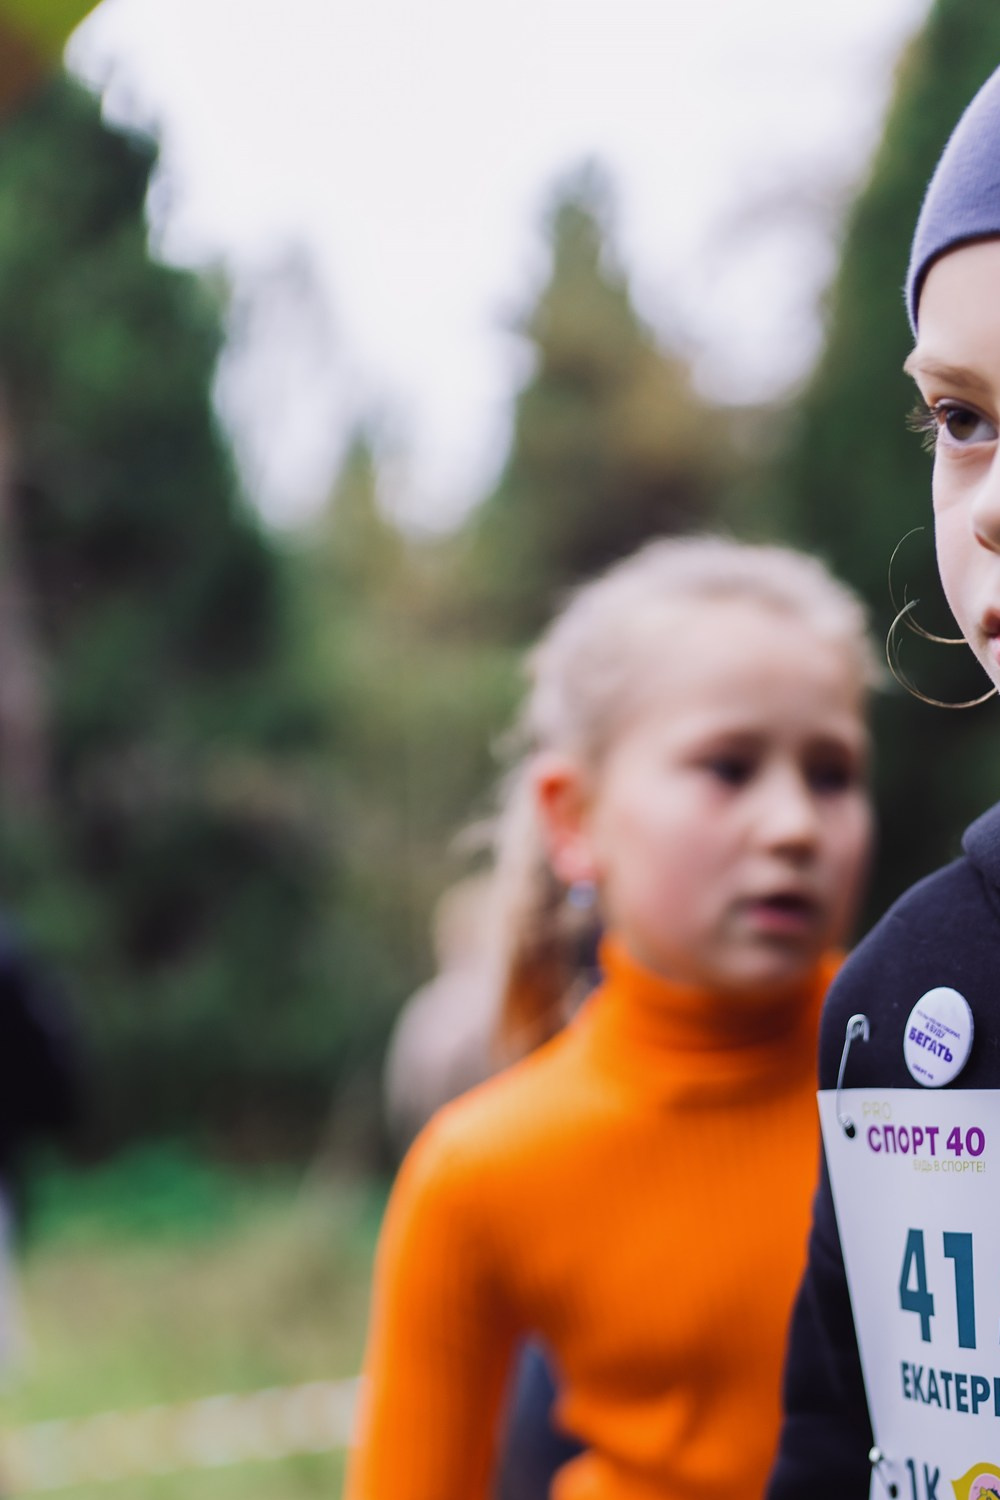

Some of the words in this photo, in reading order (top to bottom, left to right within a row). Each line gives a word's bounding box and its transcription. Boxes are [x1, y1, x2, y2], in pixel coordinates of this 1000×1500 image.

[908, 1026, 954, 1063] БЕГАТЬ
[862, 1101, 892, 1119] PRO
[867, 1125, 939, 1156] СПОРТ
[946, 1126, 986, 1157] 40
[934, 1161, 941, 1172] В
[942, 1161, 986, 1173] СПОРТЕ!
